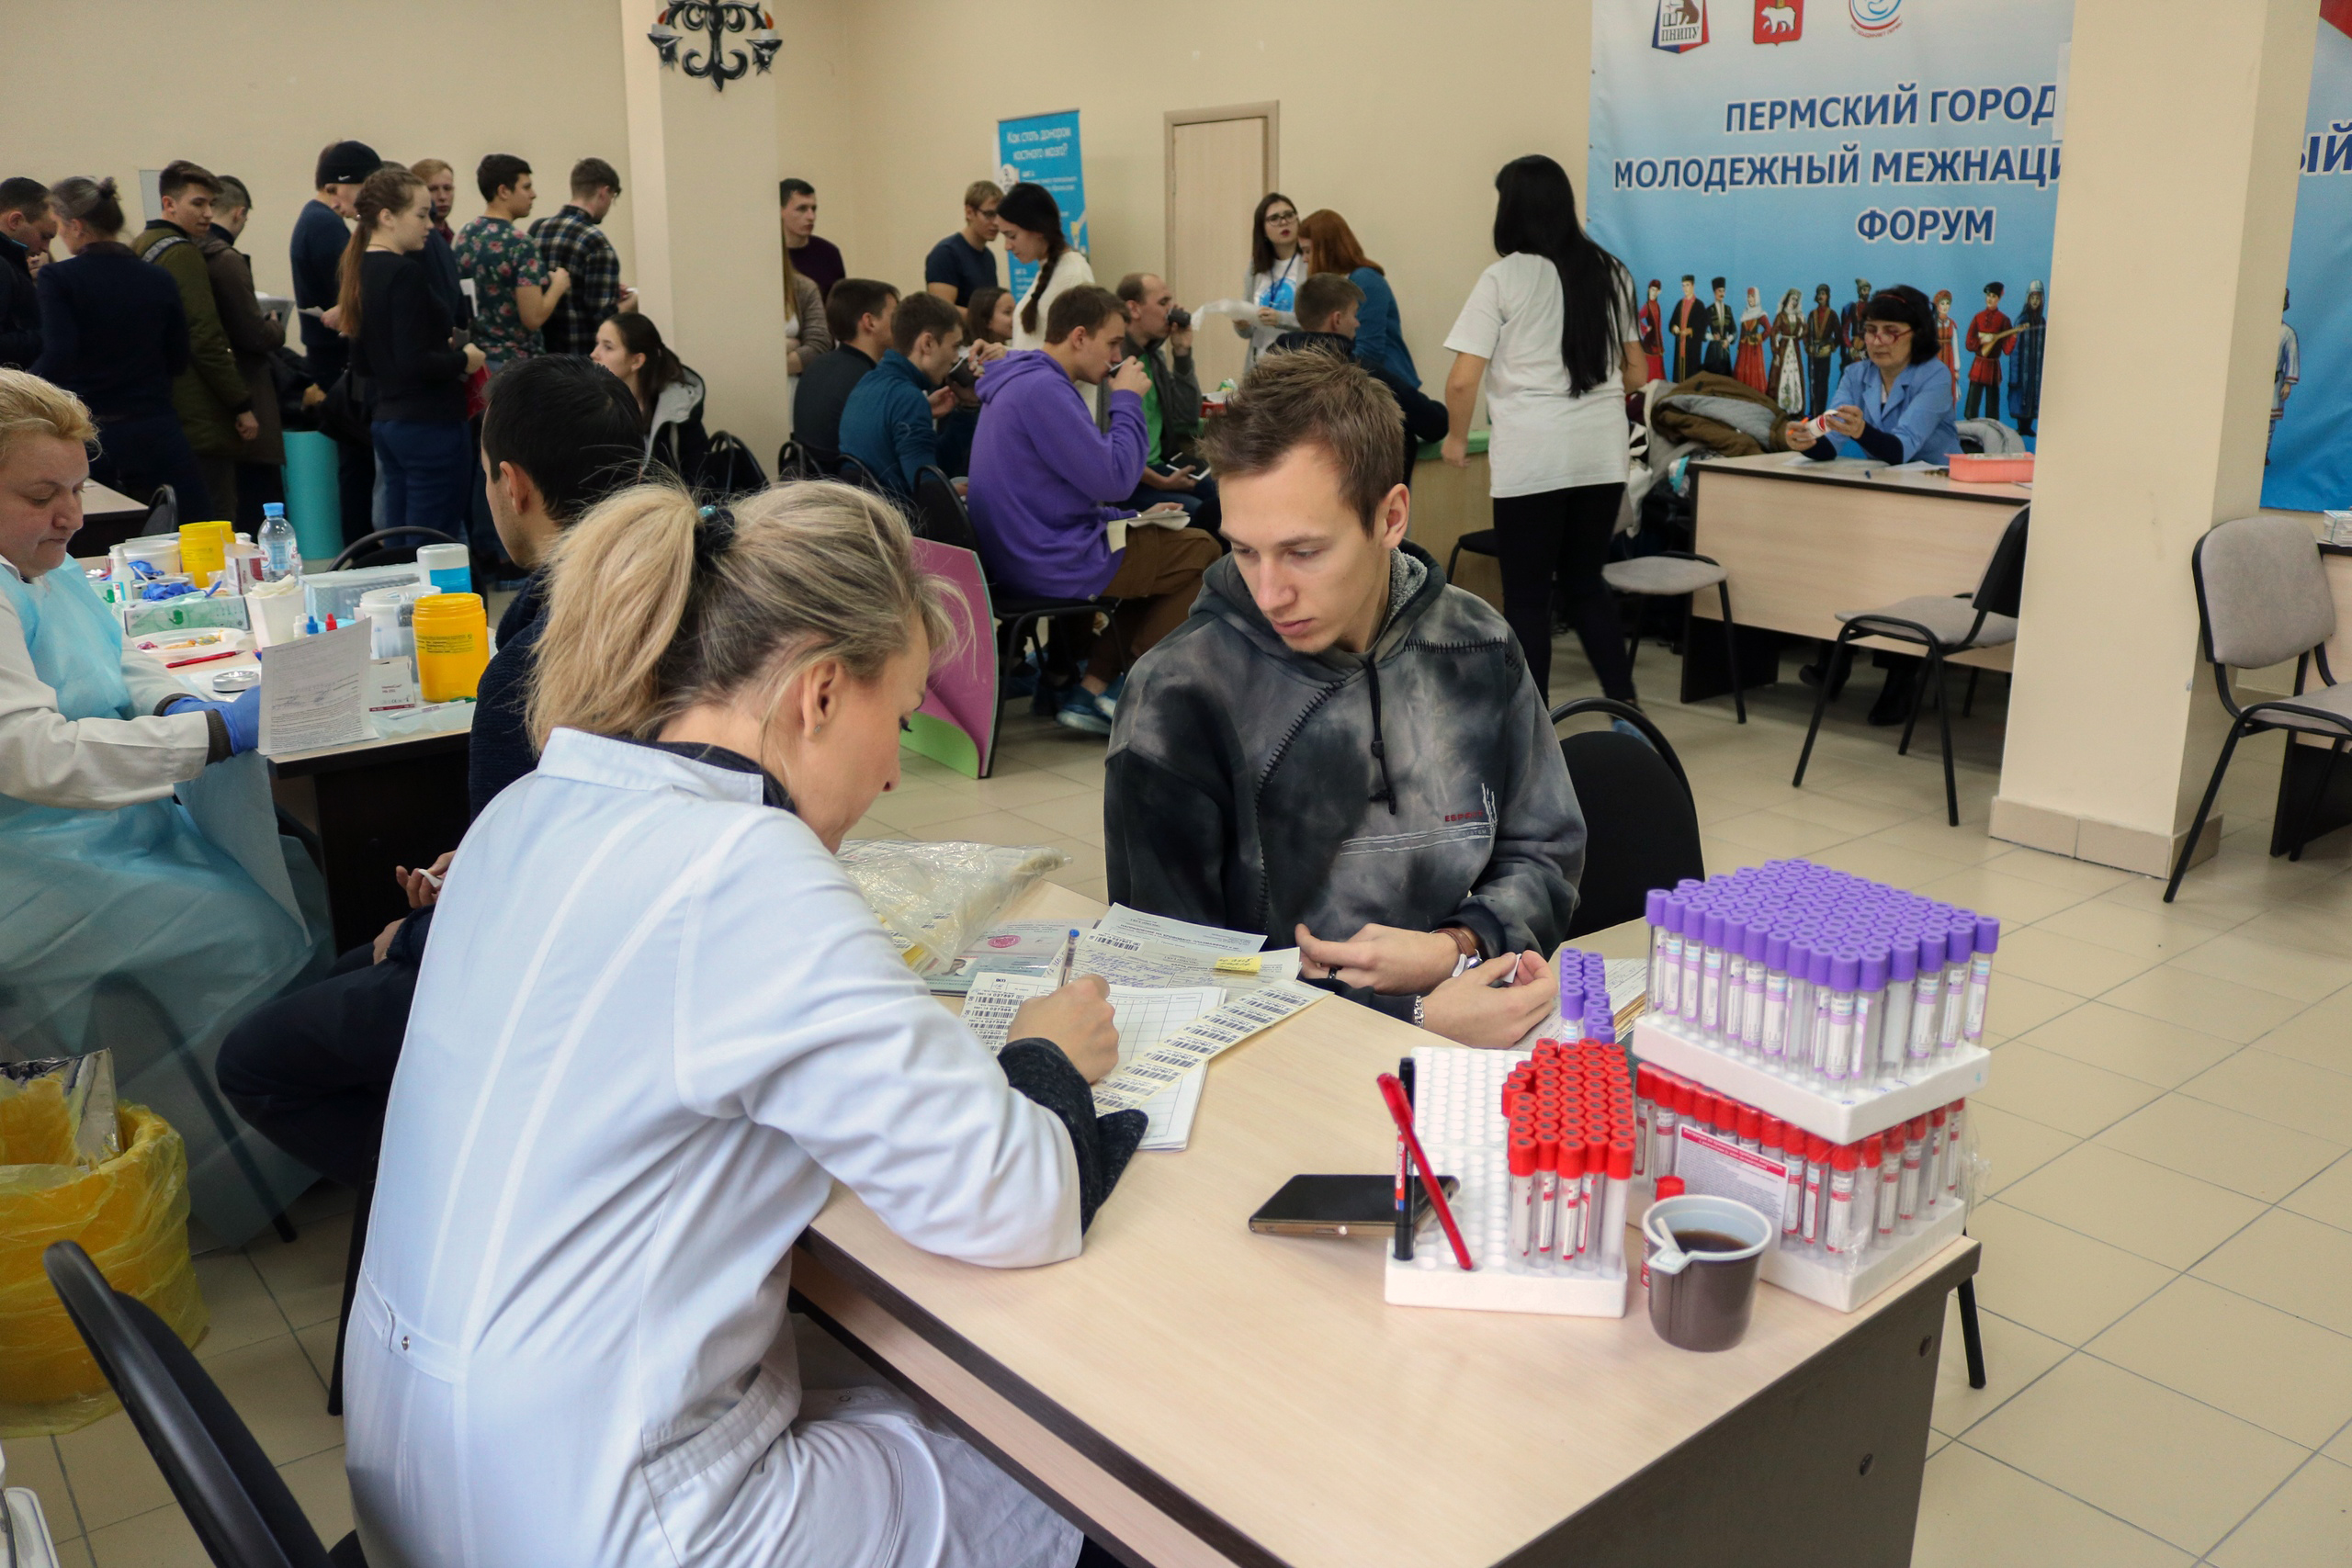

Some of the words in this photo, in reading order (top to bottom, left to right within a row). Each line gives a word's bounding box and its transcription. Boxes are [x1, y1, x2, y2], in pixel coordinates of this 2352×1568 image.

[1660, 26, 1700, 42] ПНИПУ
[1725, 83, 1918, 132] ПЕРМСКИЙ
[1614, 142, 1860, 193] МОЛОДЕЖНЫЙ
[1857, 209, 1995, 242] ФОРУМ
[1445, 810, 1483, 822] ESPRIT
[1396, 1141, 1405, 1190] edding
